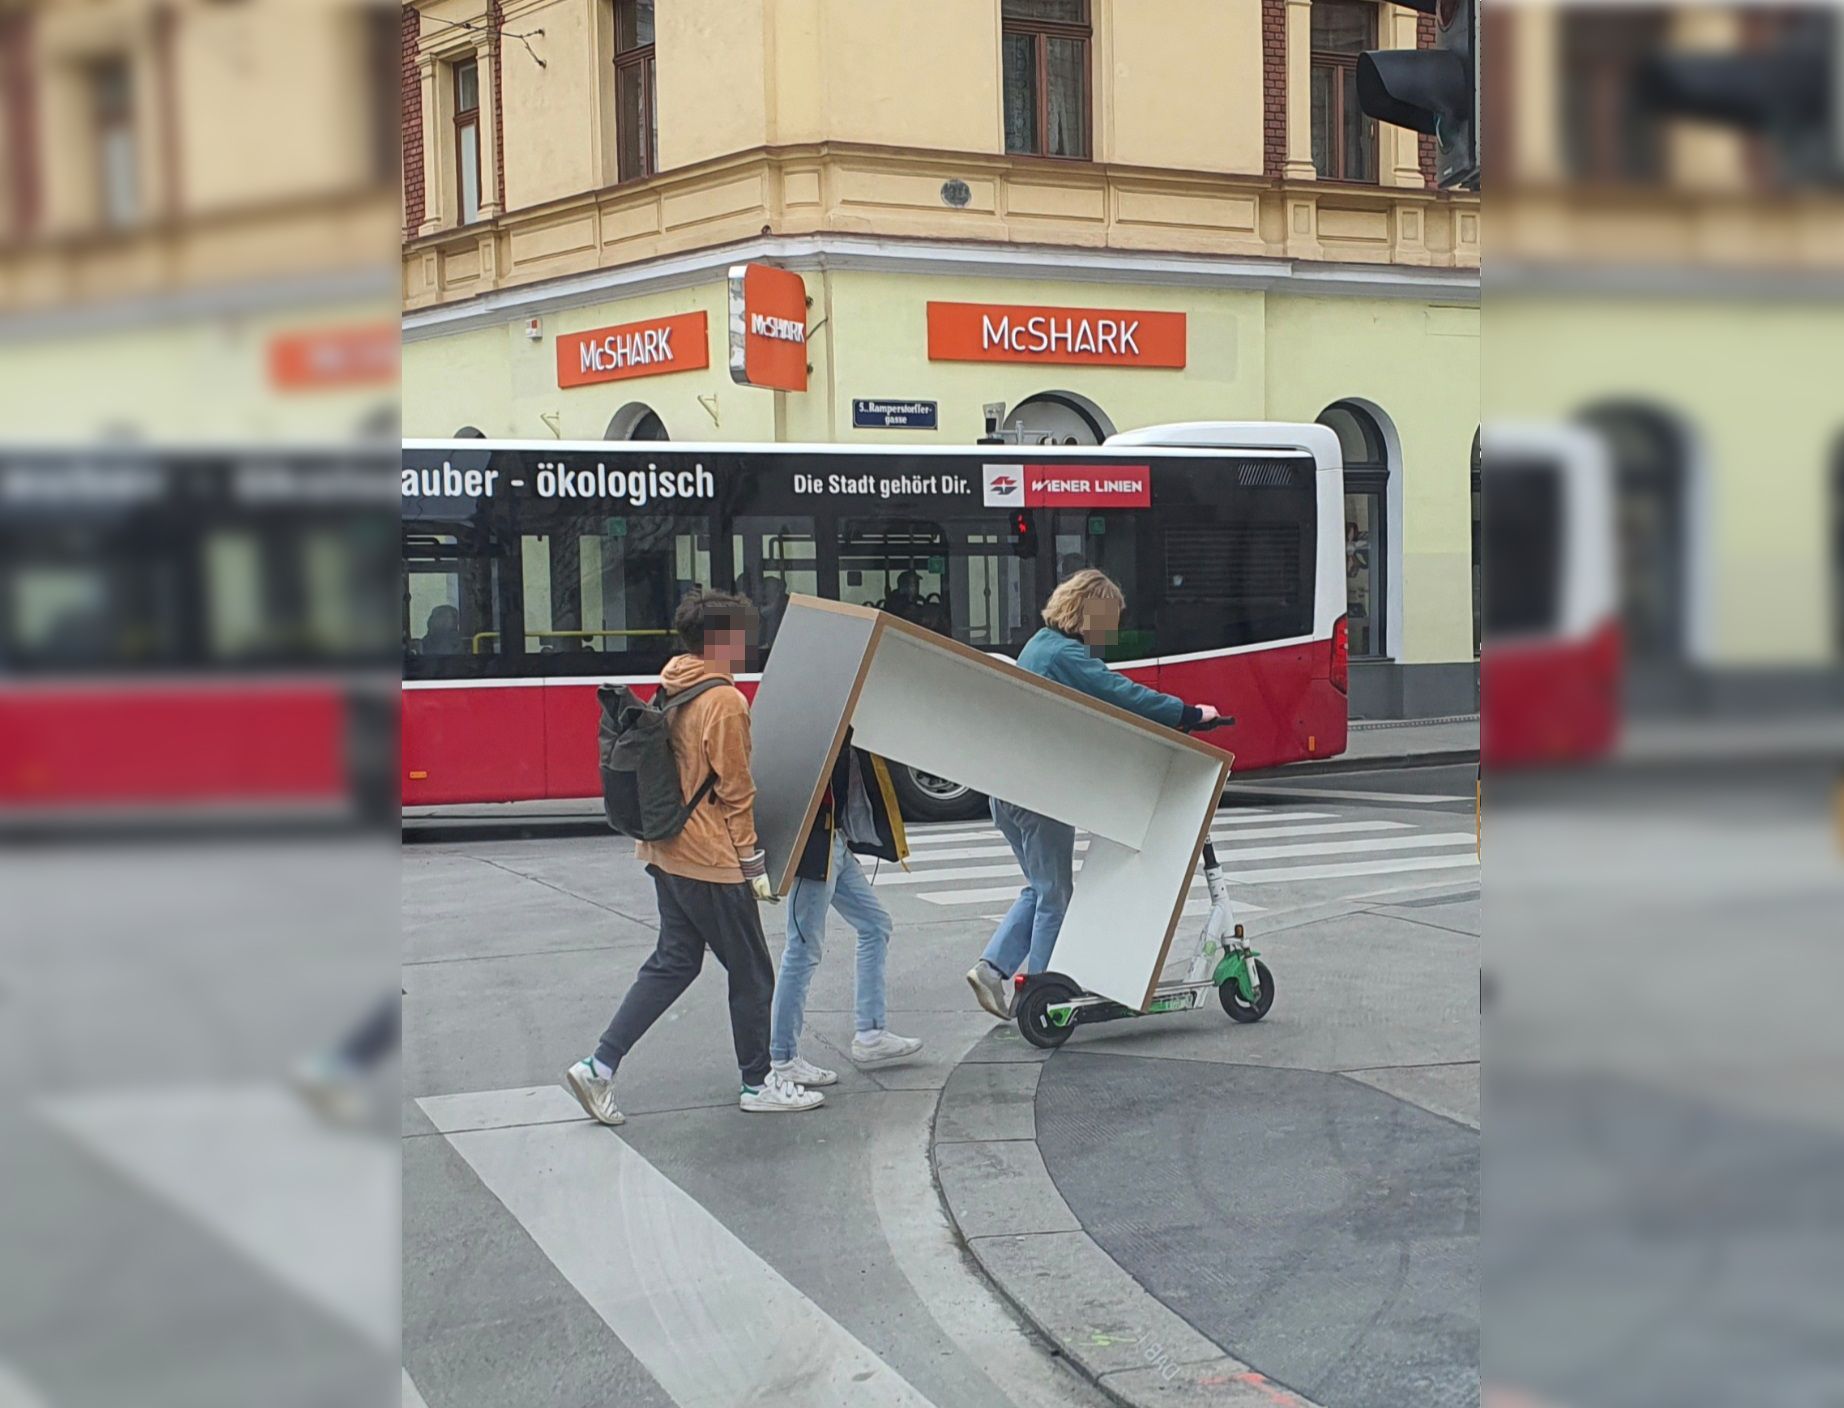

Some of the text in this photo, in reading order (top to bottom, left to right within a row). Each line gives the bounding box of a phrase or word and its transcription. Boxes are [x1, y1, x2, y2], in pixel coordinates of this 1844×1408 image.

[751, 313, 805, 343] McSHARK
[981, 314, 1141, 356] McSHARK
[579, 326, 675, 374] McSHARK
[885, 415, 908, 427] gasse
[537, 463, 714, 506] ökologisch
[794, 474, 971, 499] Die Stadt gehört Dir.
[1031, 479, 1142, 494] WIENER LINIEN
